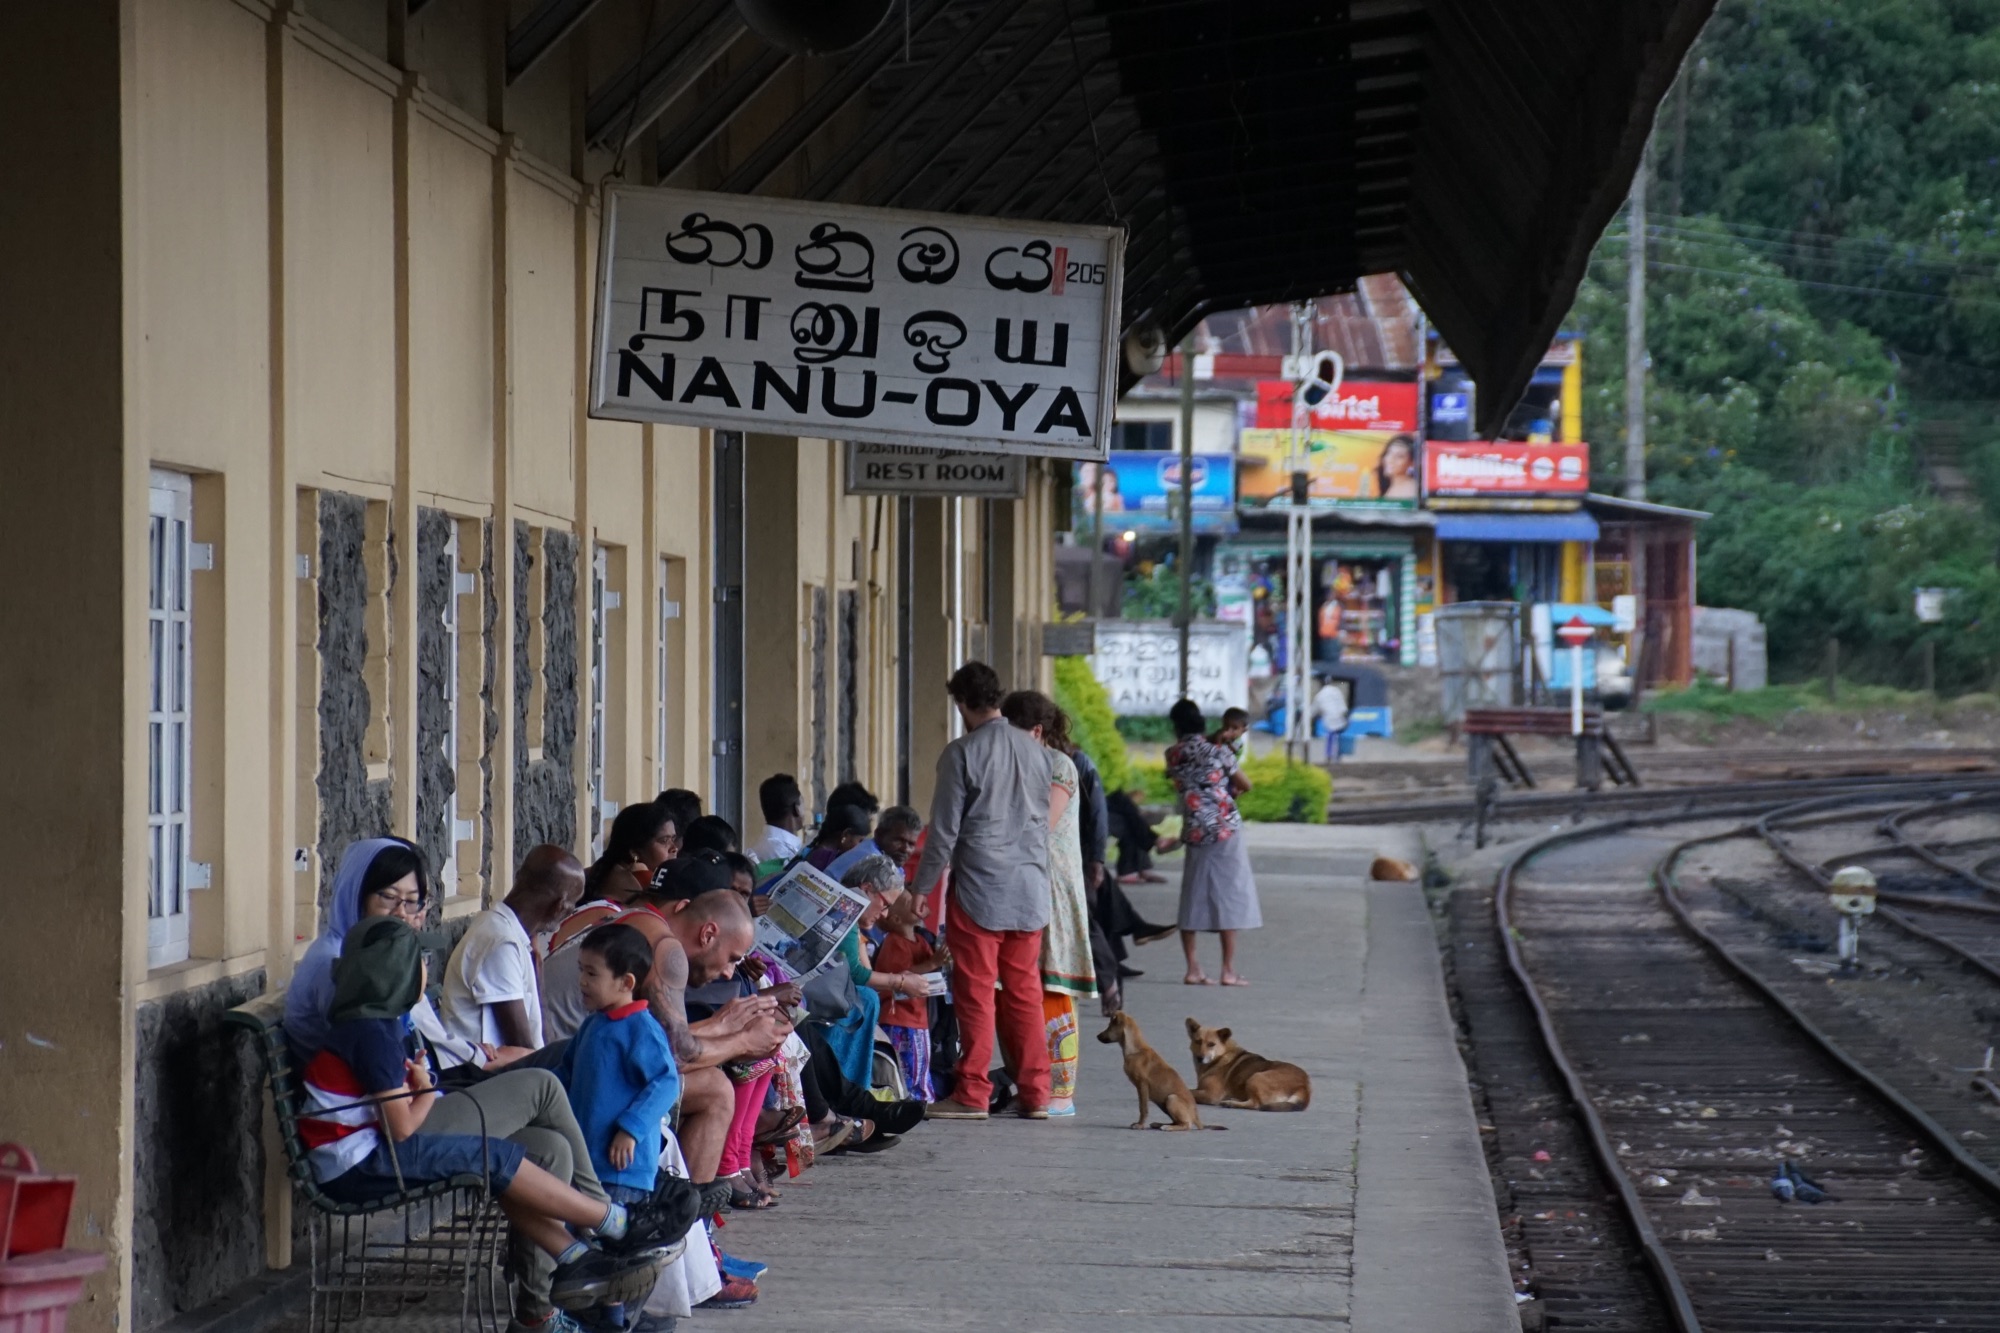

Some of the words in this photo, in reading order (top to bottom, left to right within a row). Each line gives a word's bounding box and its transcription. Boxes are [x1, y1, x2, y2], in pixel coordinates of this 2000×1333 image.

[1066, 261, 1106, 285] 205
[616, 348, 1093, 437] NANU-OYA
[866, 462, 929, 481] REST
[936, 463, 1005, 482] ROOM
